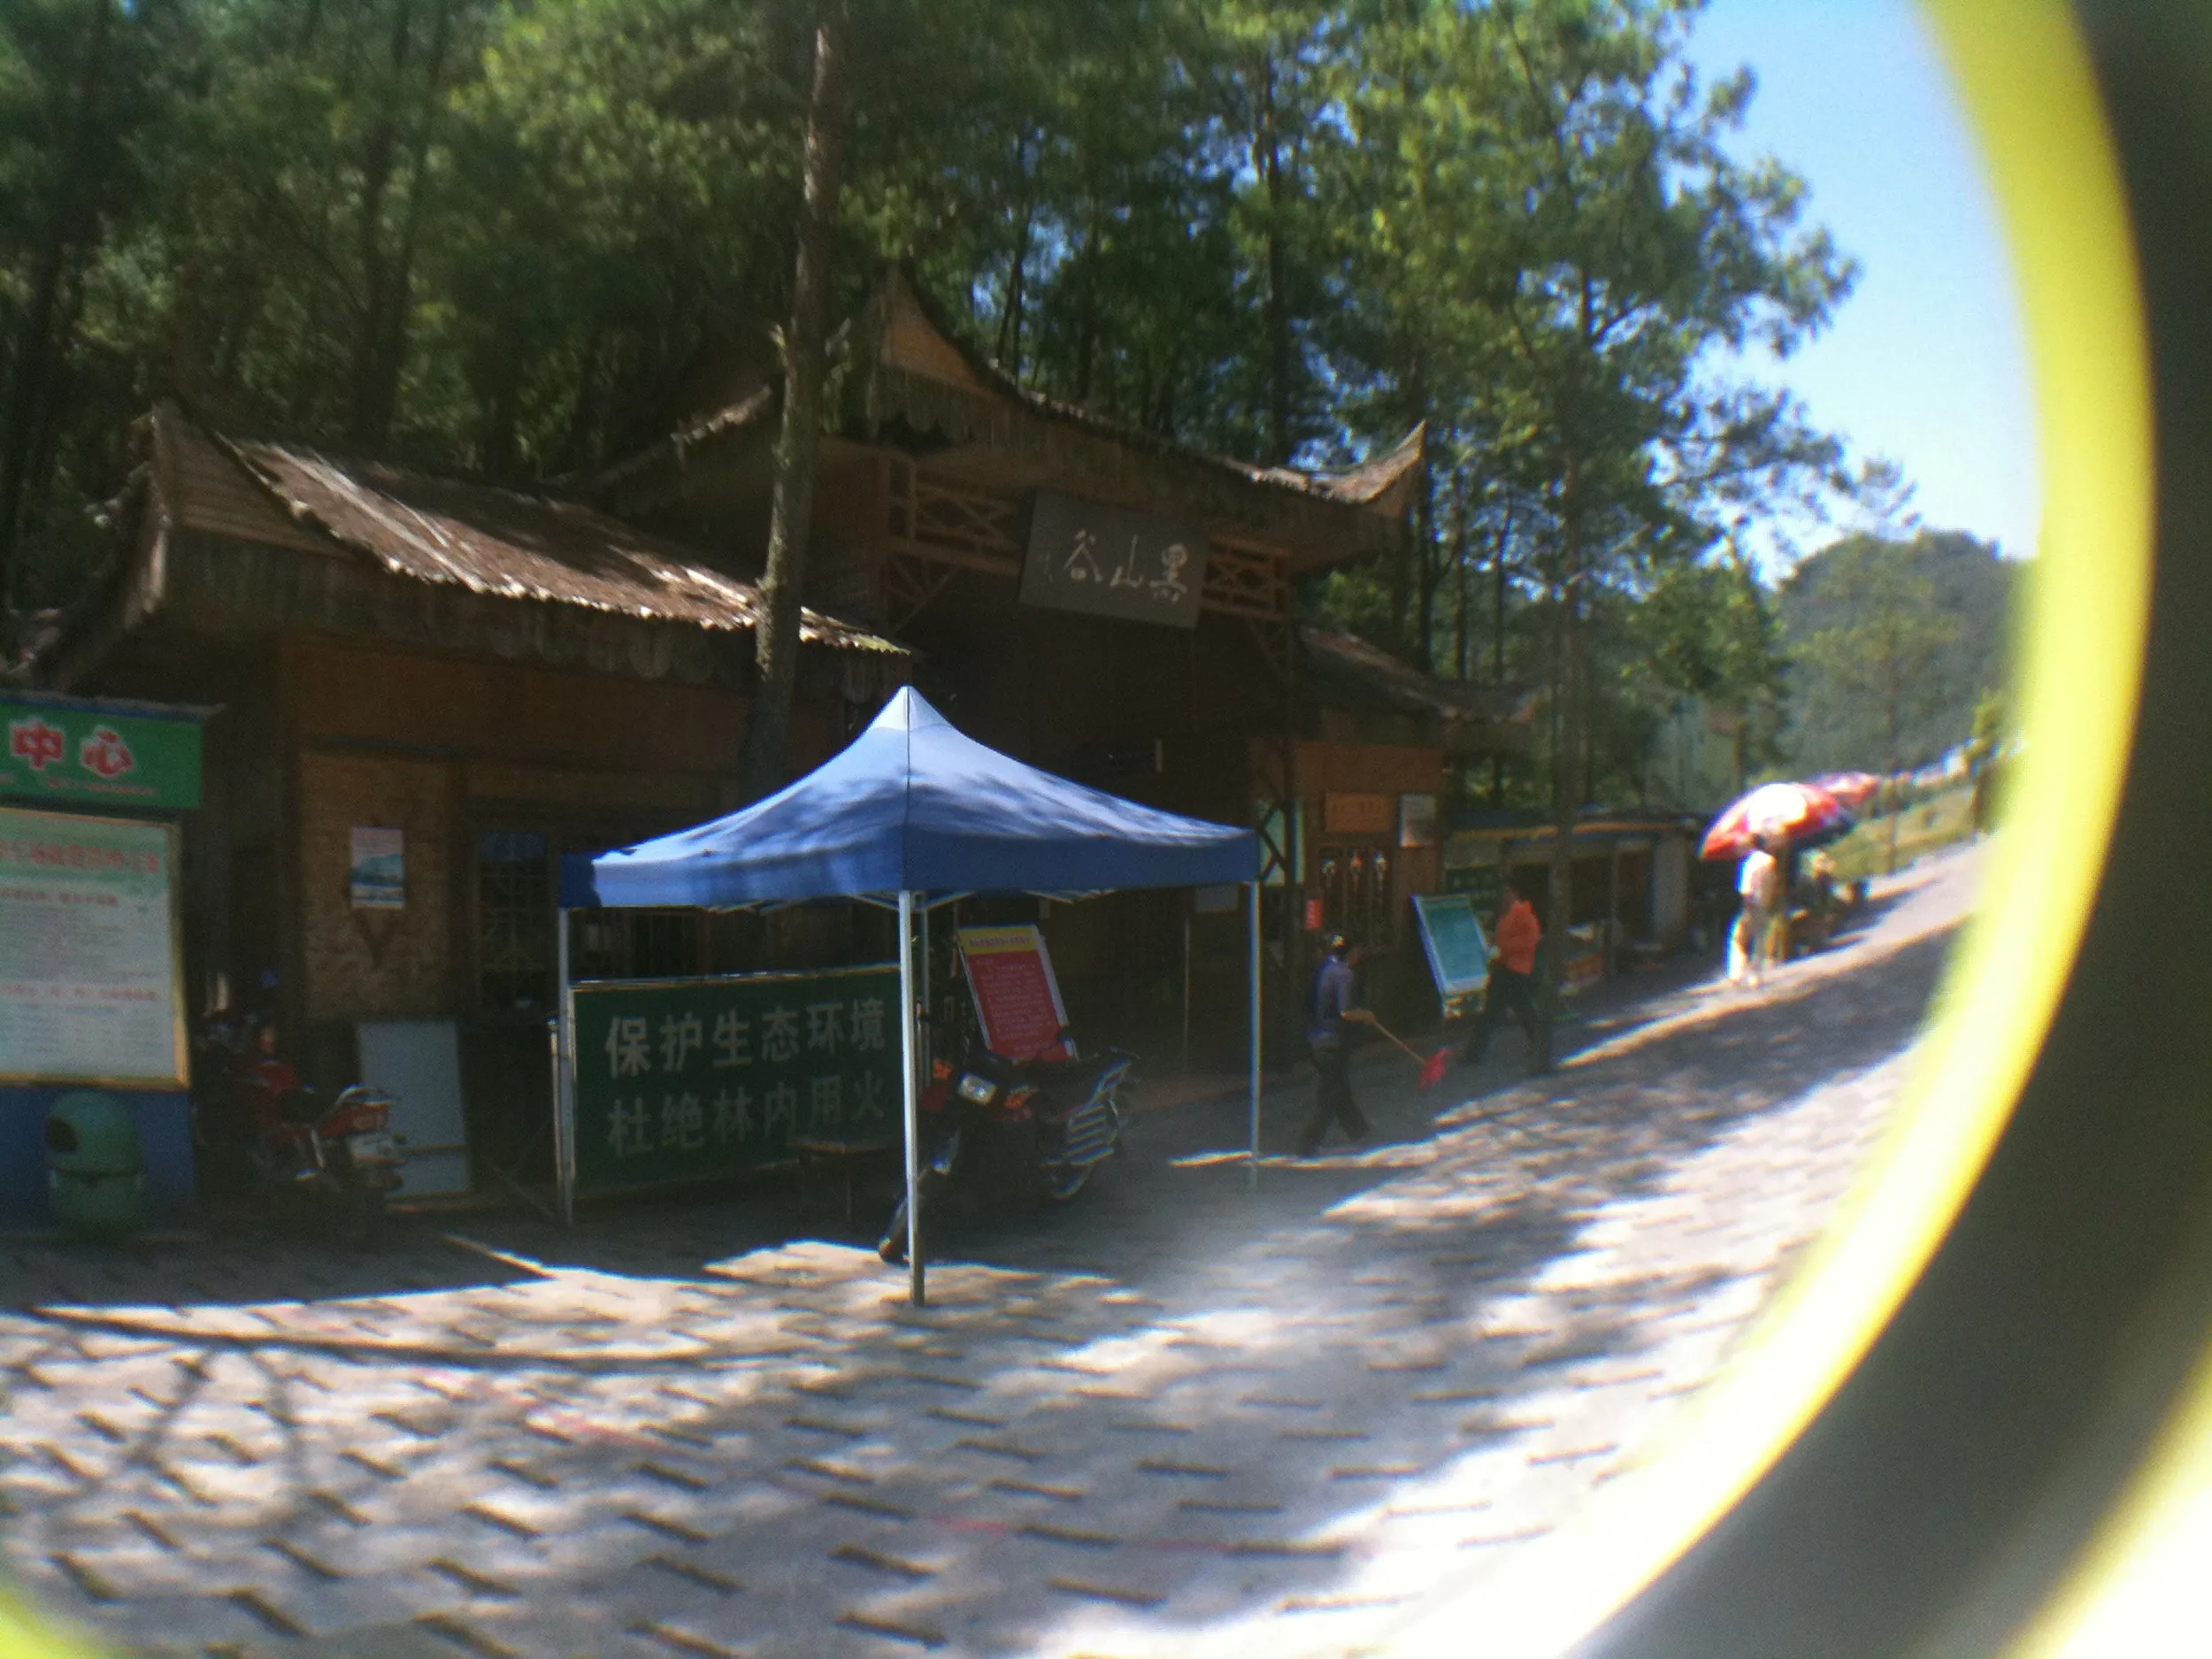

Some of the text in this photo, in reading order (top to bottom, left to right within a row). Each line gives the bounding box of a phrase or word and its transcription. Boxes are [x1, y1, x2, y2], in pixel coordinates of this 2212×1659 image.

[9, 715, 135, 778] 中心
[604, 996, 885, 1079] 保护生态环境
[607, 1070, 884, 1155] 杜绝林内用火
